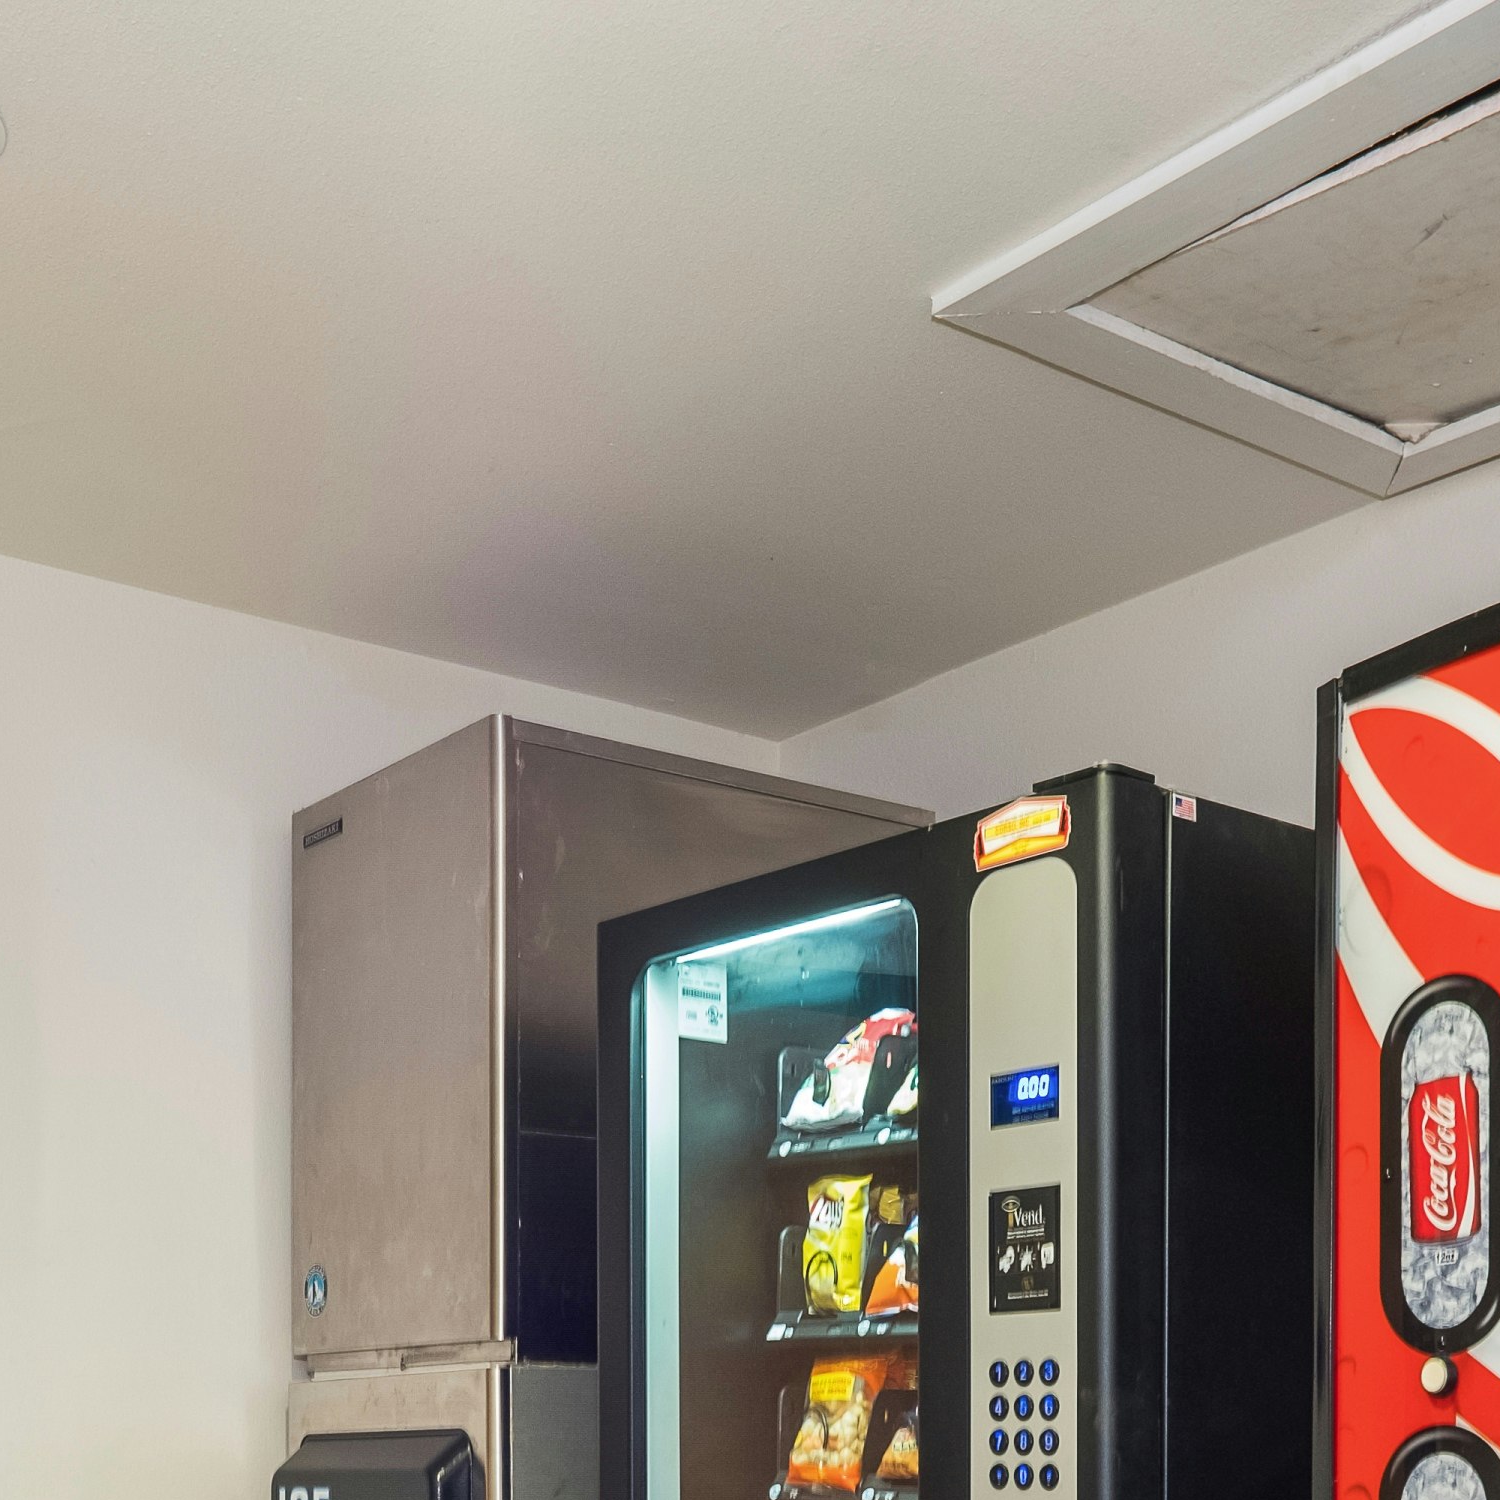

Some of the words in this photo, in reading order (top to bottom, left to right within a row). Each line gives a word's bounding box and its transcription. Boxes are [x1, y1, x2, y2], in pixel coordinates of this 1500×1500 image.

[1436, 1250, 1456, 1264] 12oz
[1019, 1362, 1027, 1381] 2
[994, 1397, 1002, 1417] 4
[995, 1430, 1003, 1451] 7
[1044, 1431, 1053, 1451] 9
[1019, 1464, 1028, 1485] 0
